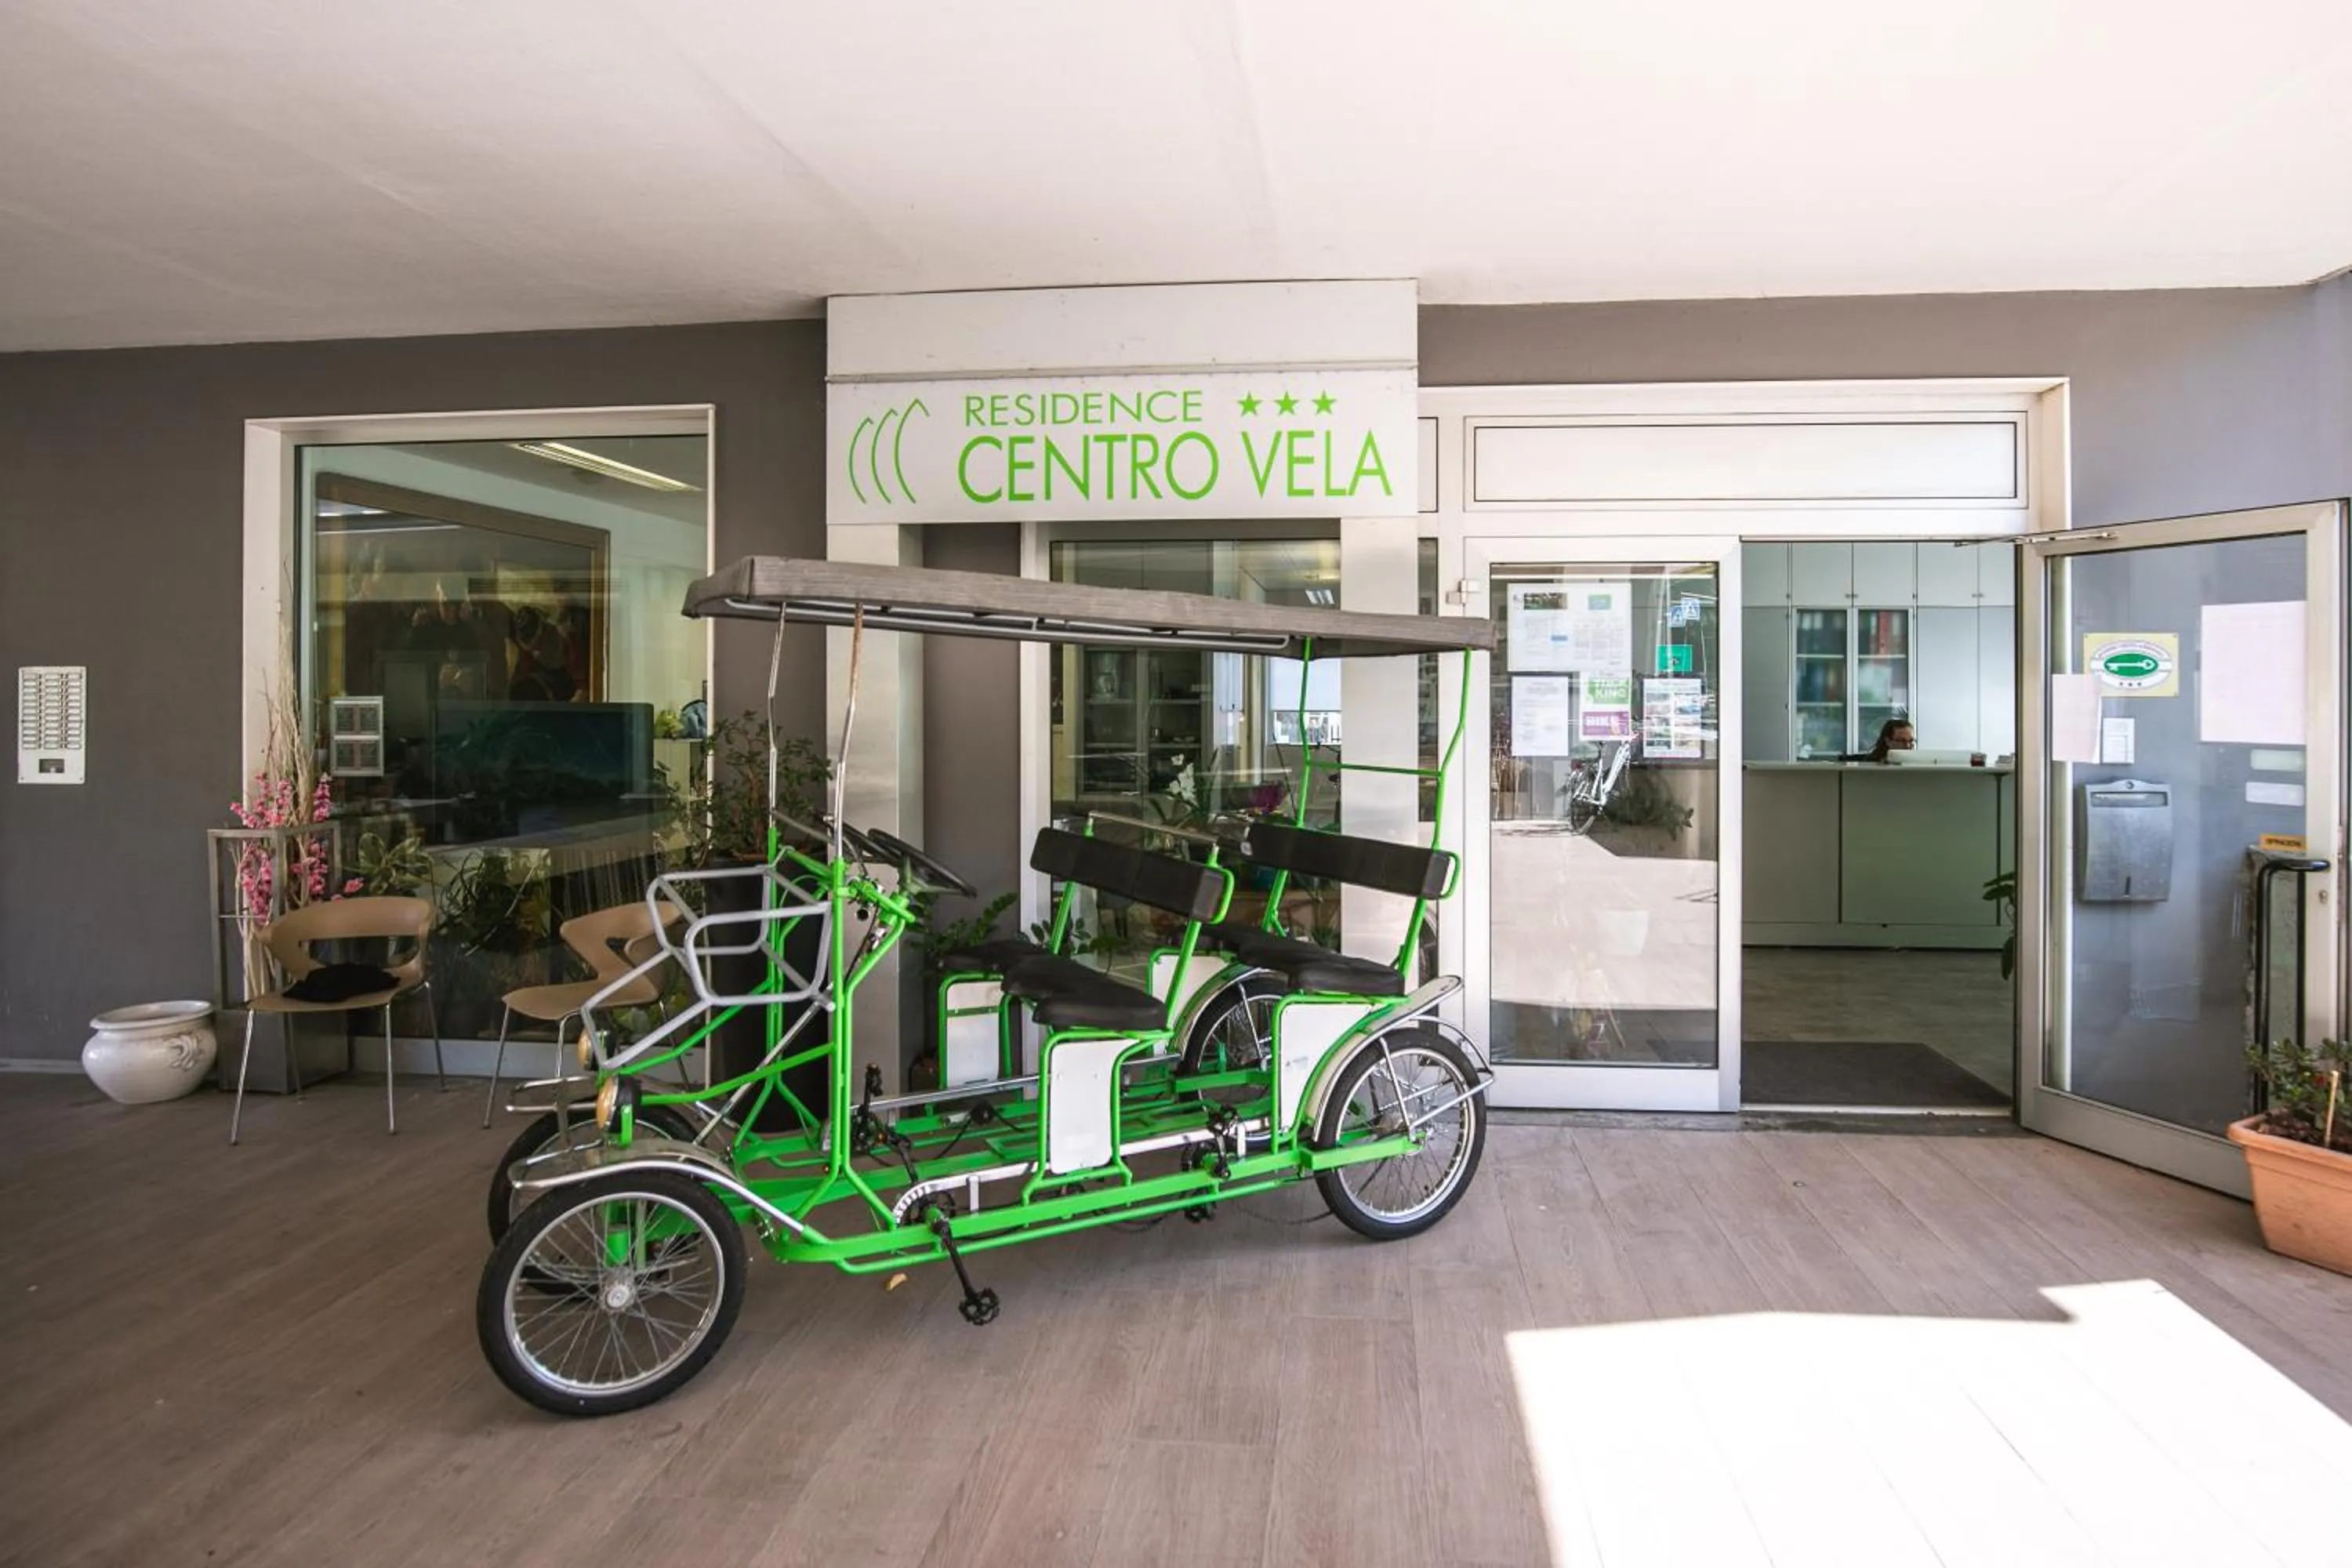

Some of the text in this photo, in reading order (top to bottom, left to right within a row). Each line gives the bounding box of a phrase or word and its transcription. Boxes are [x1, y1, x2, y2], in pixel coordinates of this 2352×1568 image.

[965, 390, 1203, 426] RESIDENCE
[957, 428, 1393, 504] CENTRO VELA
